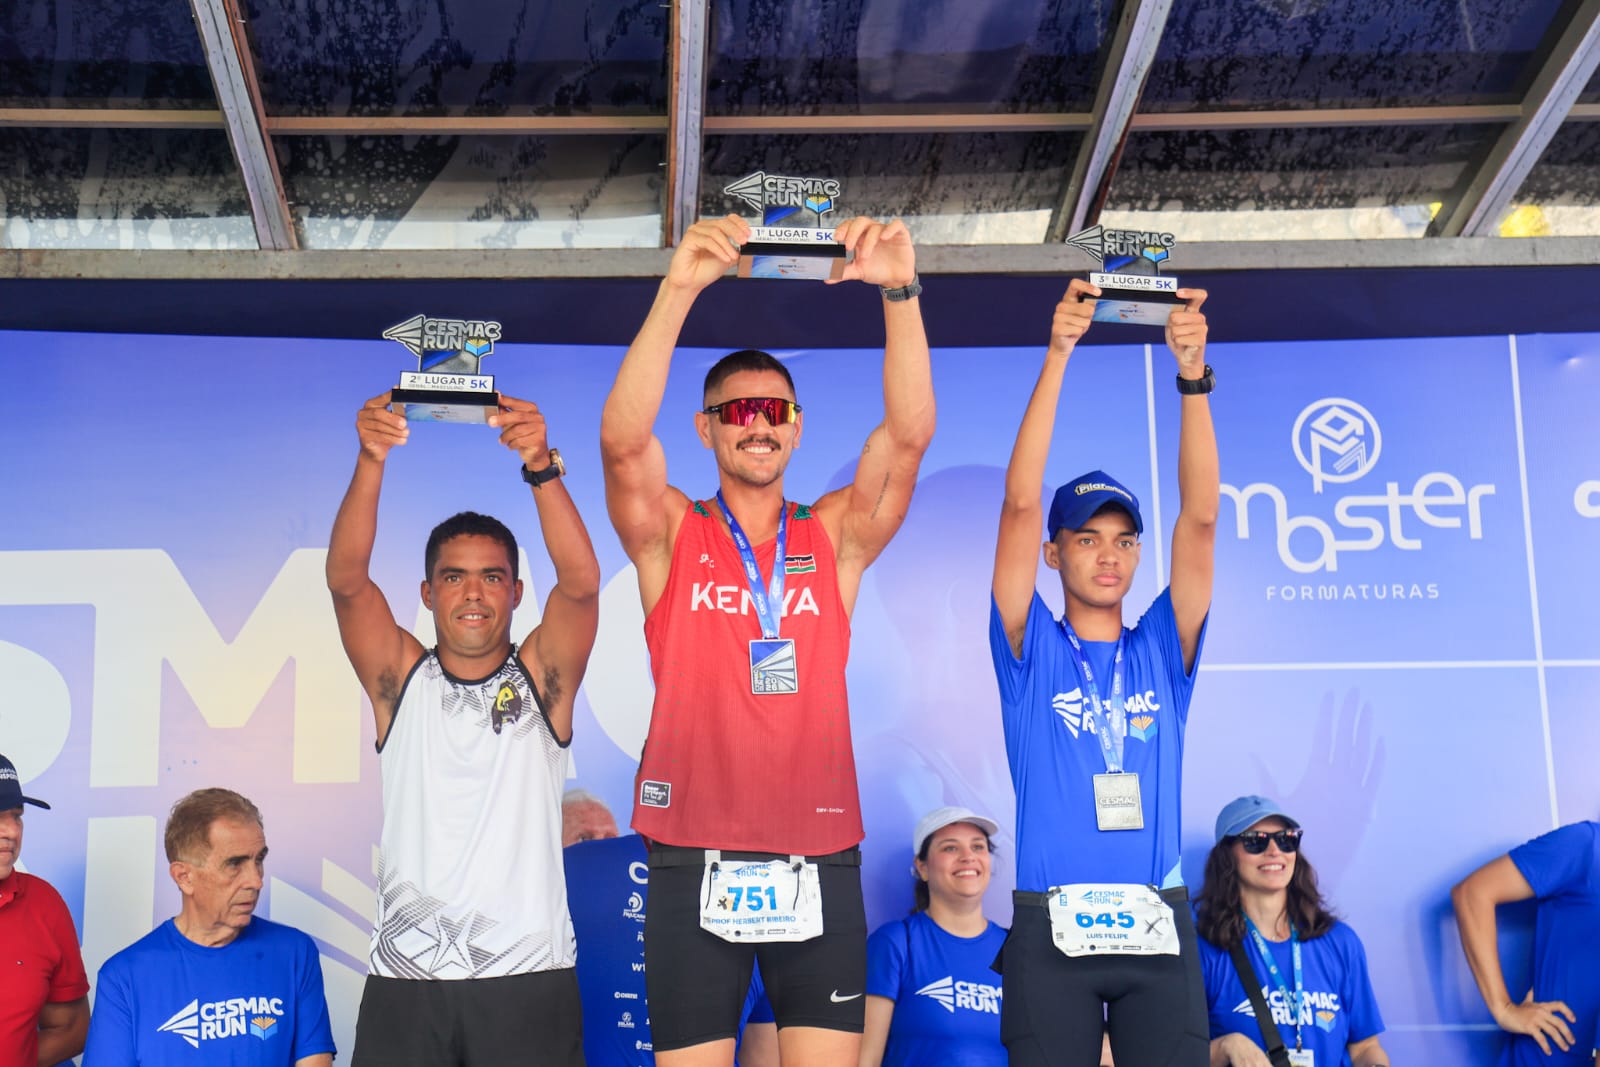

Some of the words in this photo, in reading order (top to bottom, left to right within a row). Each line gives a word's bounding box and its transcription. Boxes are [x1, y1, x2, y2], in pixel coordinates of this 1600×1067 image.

[764, 177, 838, 196] CESMAC
[764, 192, 802, 206] RUN
[768, 229, 809, 238] LUGAR
[815, 231, 833, 241] 5K
[1103, 229, 1175, 247] CESMAC
[1104, 243, 1141, 256] RUN
[1112, 276, 1151, 285] LUGAR
[1155, 280, 1173, 290] 5K
[423, 321, 500, 338] CESMAC
[423, 334, 462, 350] RUN
[424, 376, 466, 385] LUGAR
[470, 379, 488, 389] 5K
[1219, 471, 1496, 573] master
[1266, 583, 1440, 601] FORMATURAS
[727, 885, 777, 912] 751
[1093, 890, 1125, 898] CESMAC
[1093, 897, 1111, 905] RUN
[1075, 911, 1135, 929] 645
[954, 980, 1003, 1000] CESM
[200, 996, 284, 1022] CESMAC
[955, 993, 1000, 1015] RUN
[201, 1013, 247, 1040] RUN
